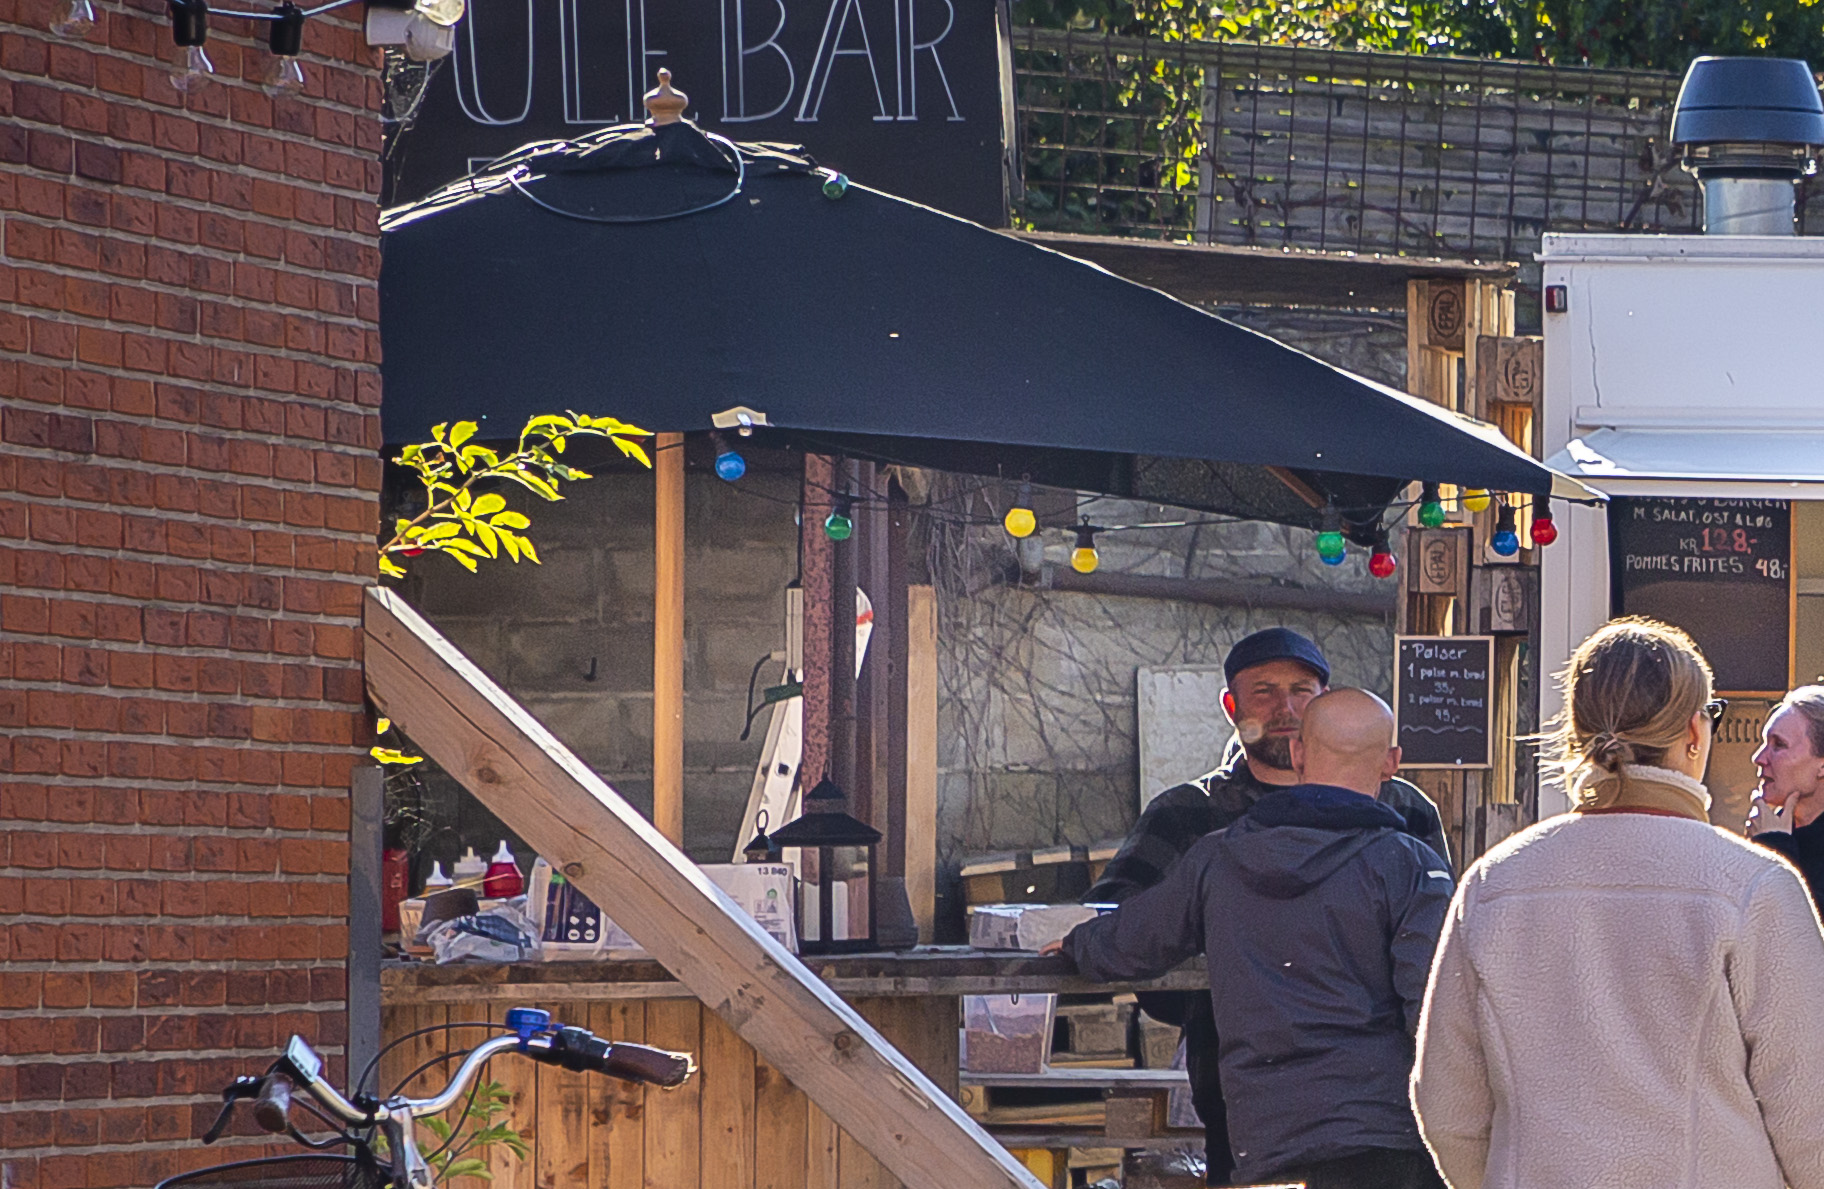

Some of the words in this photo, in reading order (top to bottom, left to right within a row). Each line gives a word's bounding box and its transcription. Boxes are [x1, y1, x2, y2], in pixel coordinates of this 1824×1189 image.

[720, 0, 965, 122] BAR
[1702, 511, 1729, 525] OST
[1626, 554, 1680, 572] POMMES
[1683, 556, 1744, 574] FRITES
[1412, 643, 1467, 660] Pølser
[1407, 662, 1415, 678] 1
